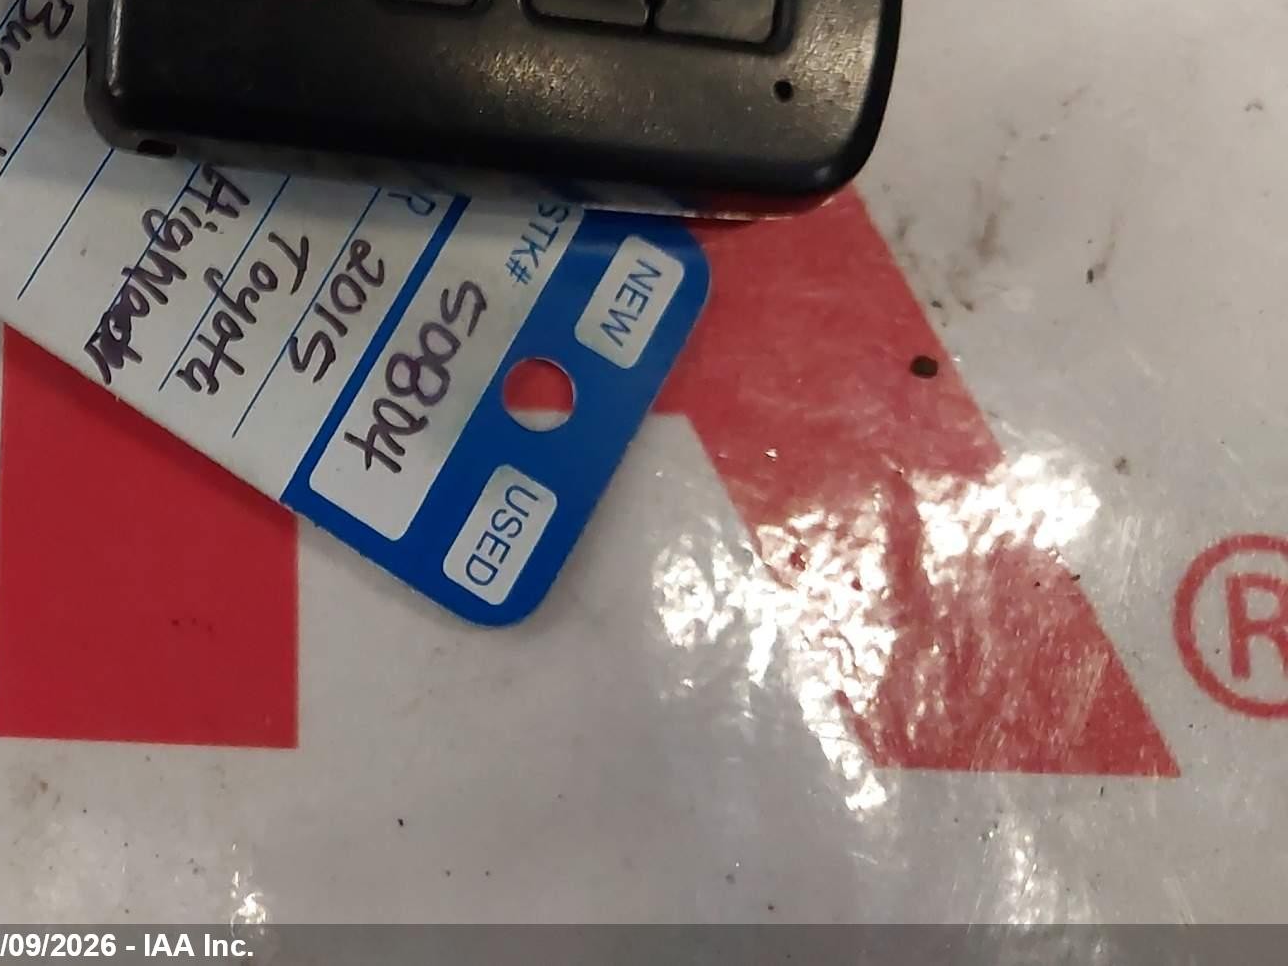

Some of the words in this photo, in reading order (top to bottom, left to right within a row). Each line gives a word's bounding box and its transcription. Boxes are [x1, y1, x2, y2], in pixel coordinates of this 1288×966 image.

[505, 199, 570, 285] STK#
[175, 232, 309, 395] Toyota
[289, 239, 385, 382] 2015
[600, 260, 662, 348] NEW
[344, 280, 489, 473] 50804
[464, 484, 539, 587] USED
